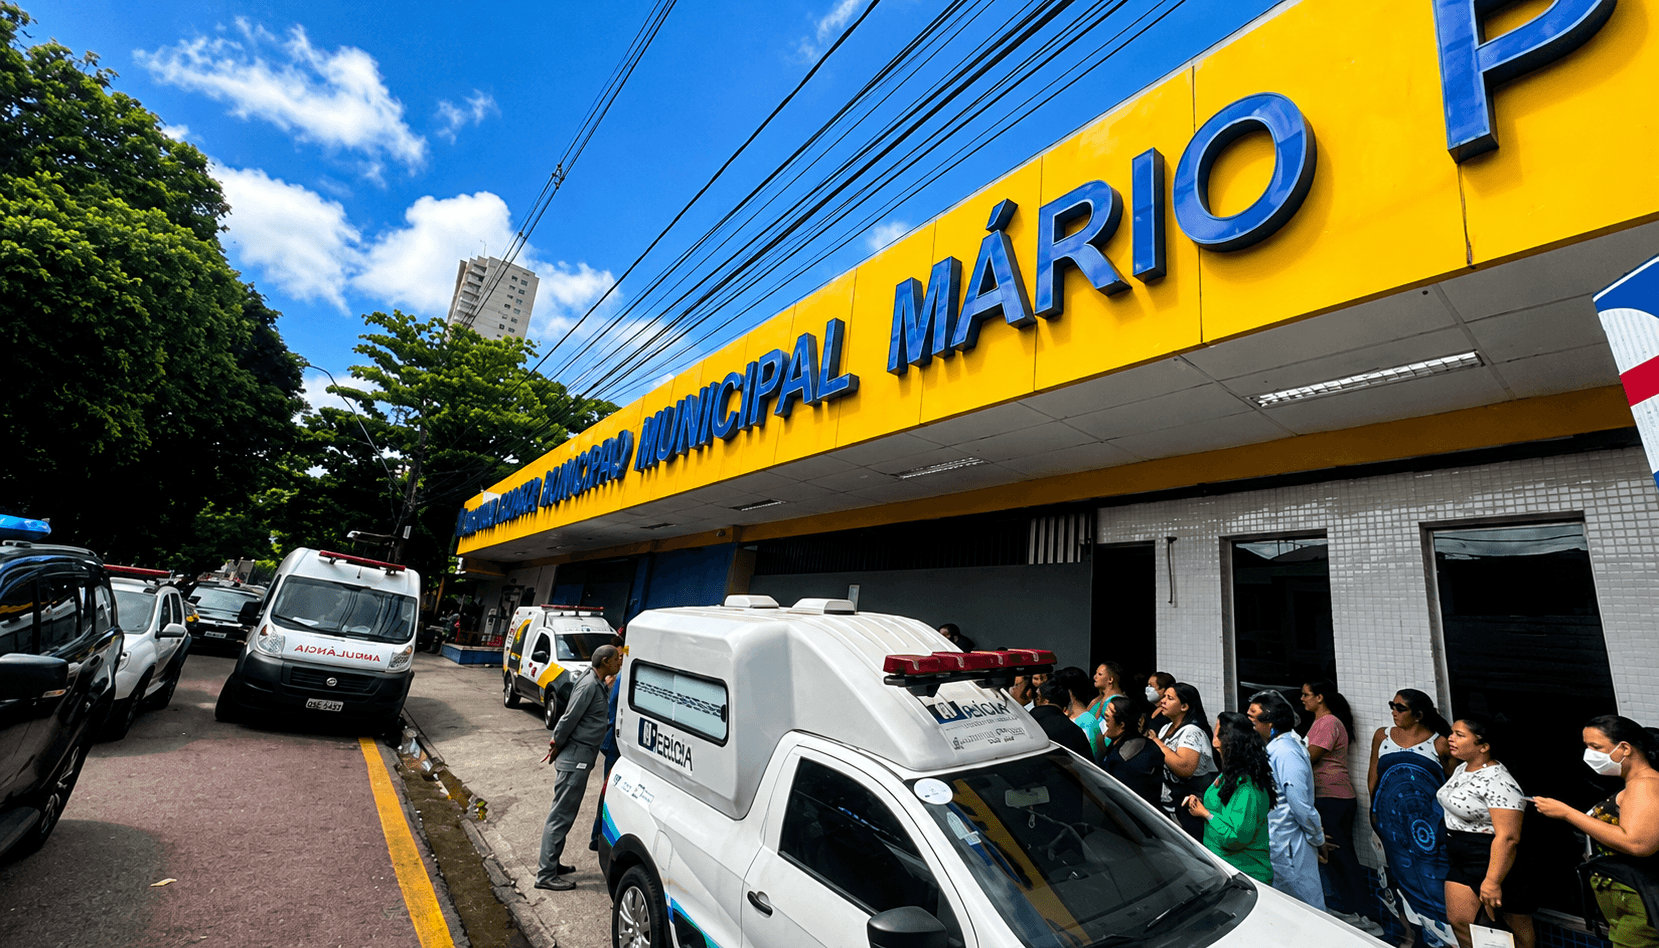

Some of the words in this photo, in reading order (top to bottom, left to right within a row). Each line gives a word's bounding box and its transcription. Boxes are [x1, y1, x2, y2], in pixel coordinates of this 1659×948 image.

[633, 317, 860, 473] MUNICIPAL
[887, 92, 1317, 377] MÁRIO
[1435, 0, 1617, 164] P
